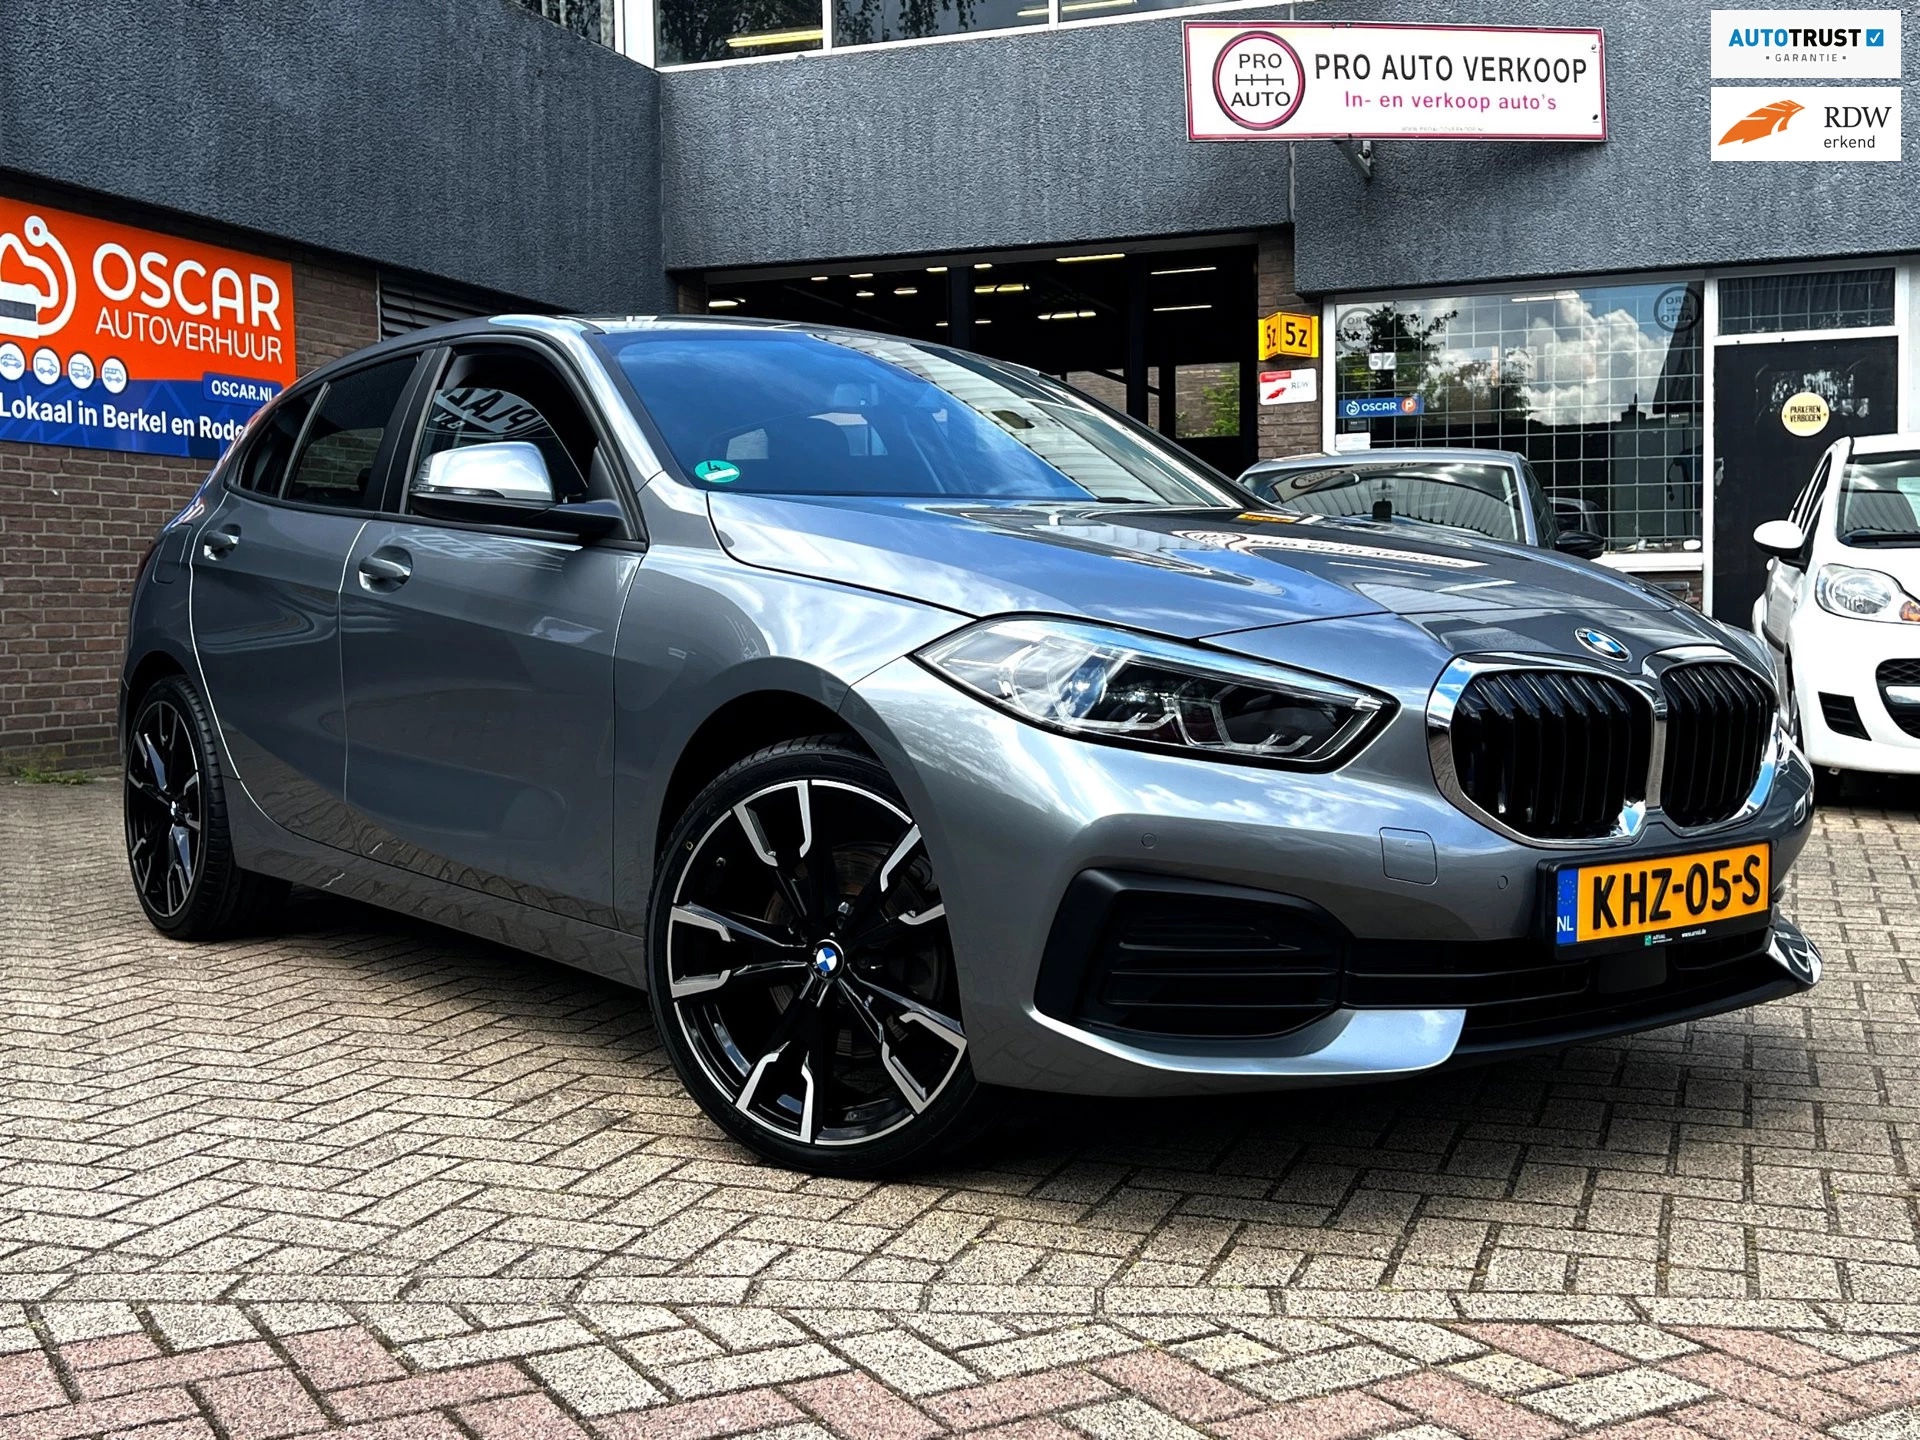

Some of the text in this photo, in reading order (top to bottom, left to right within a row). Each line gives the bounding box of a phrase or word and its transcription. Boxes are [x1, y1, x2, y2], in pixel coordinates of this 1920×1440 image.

[1239, 53, 1282, 69] PRO
[1315, 53, 1588, 84] PRO AUTO VERKOOP
[1231, 91, 1291, 107] AUTO
[1345, 91, 1557, 113] In- en verkoop auto's
[92, 242, 282, 331] OSCAR
[95, 306, 283, 364] AUTOVERHUUR
[0, 393, 73, 425] Lokaal
[78, 400, 98, 427] in
[103, 405, 167, 434] Berkel
[171, 416, 195, 437] en
[1361, 401, 1397, 412] OSCAR
[1790, 405, 1821, 413] PARKEREN
[1592, 854, 1761, 930] KHZ-05-S
[1556, 915, 1574, 932] NL
